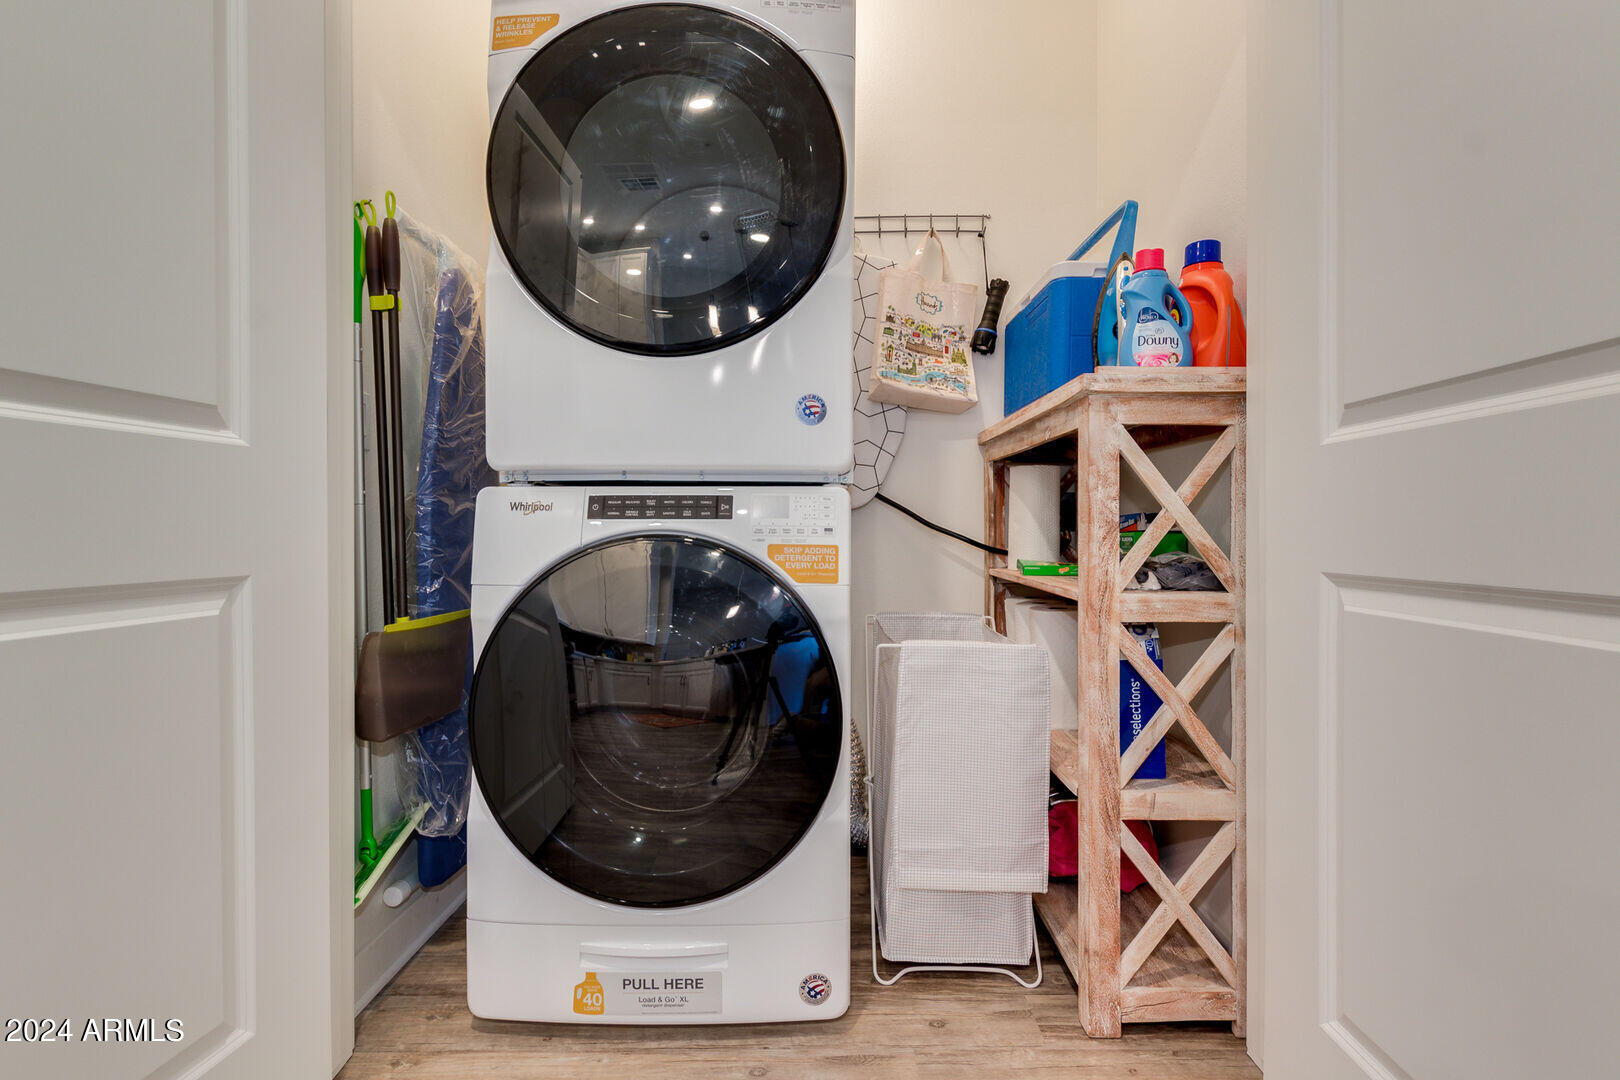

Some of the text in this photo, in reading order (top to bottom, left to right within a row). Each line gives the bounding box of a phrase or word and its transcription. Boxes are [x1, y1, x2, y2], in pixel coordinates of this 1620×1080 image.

[496, 15, 551, 25] HELP PREVENT
[503, 22, 535, 31] RELEASE
[496, 30, 533, 38] WRINKLES
[1137, 335, 1179, 349] Downy
[509, 500, 553, 515] Whirlpool
[783, 546, 836, 554] SKIP ADDING
[774, 554, 836, 562] DETERGENT TO
[785, 561, 836, 570] EVERY LOAD
[1129, 681, 1142, 740] selections
[622, 978, 704, 990] PULL HERE
[800, 975, 829, 990] AMERICA
[583, 992, 602, 1006] 40
[679, 995, 689, 1003] XL
